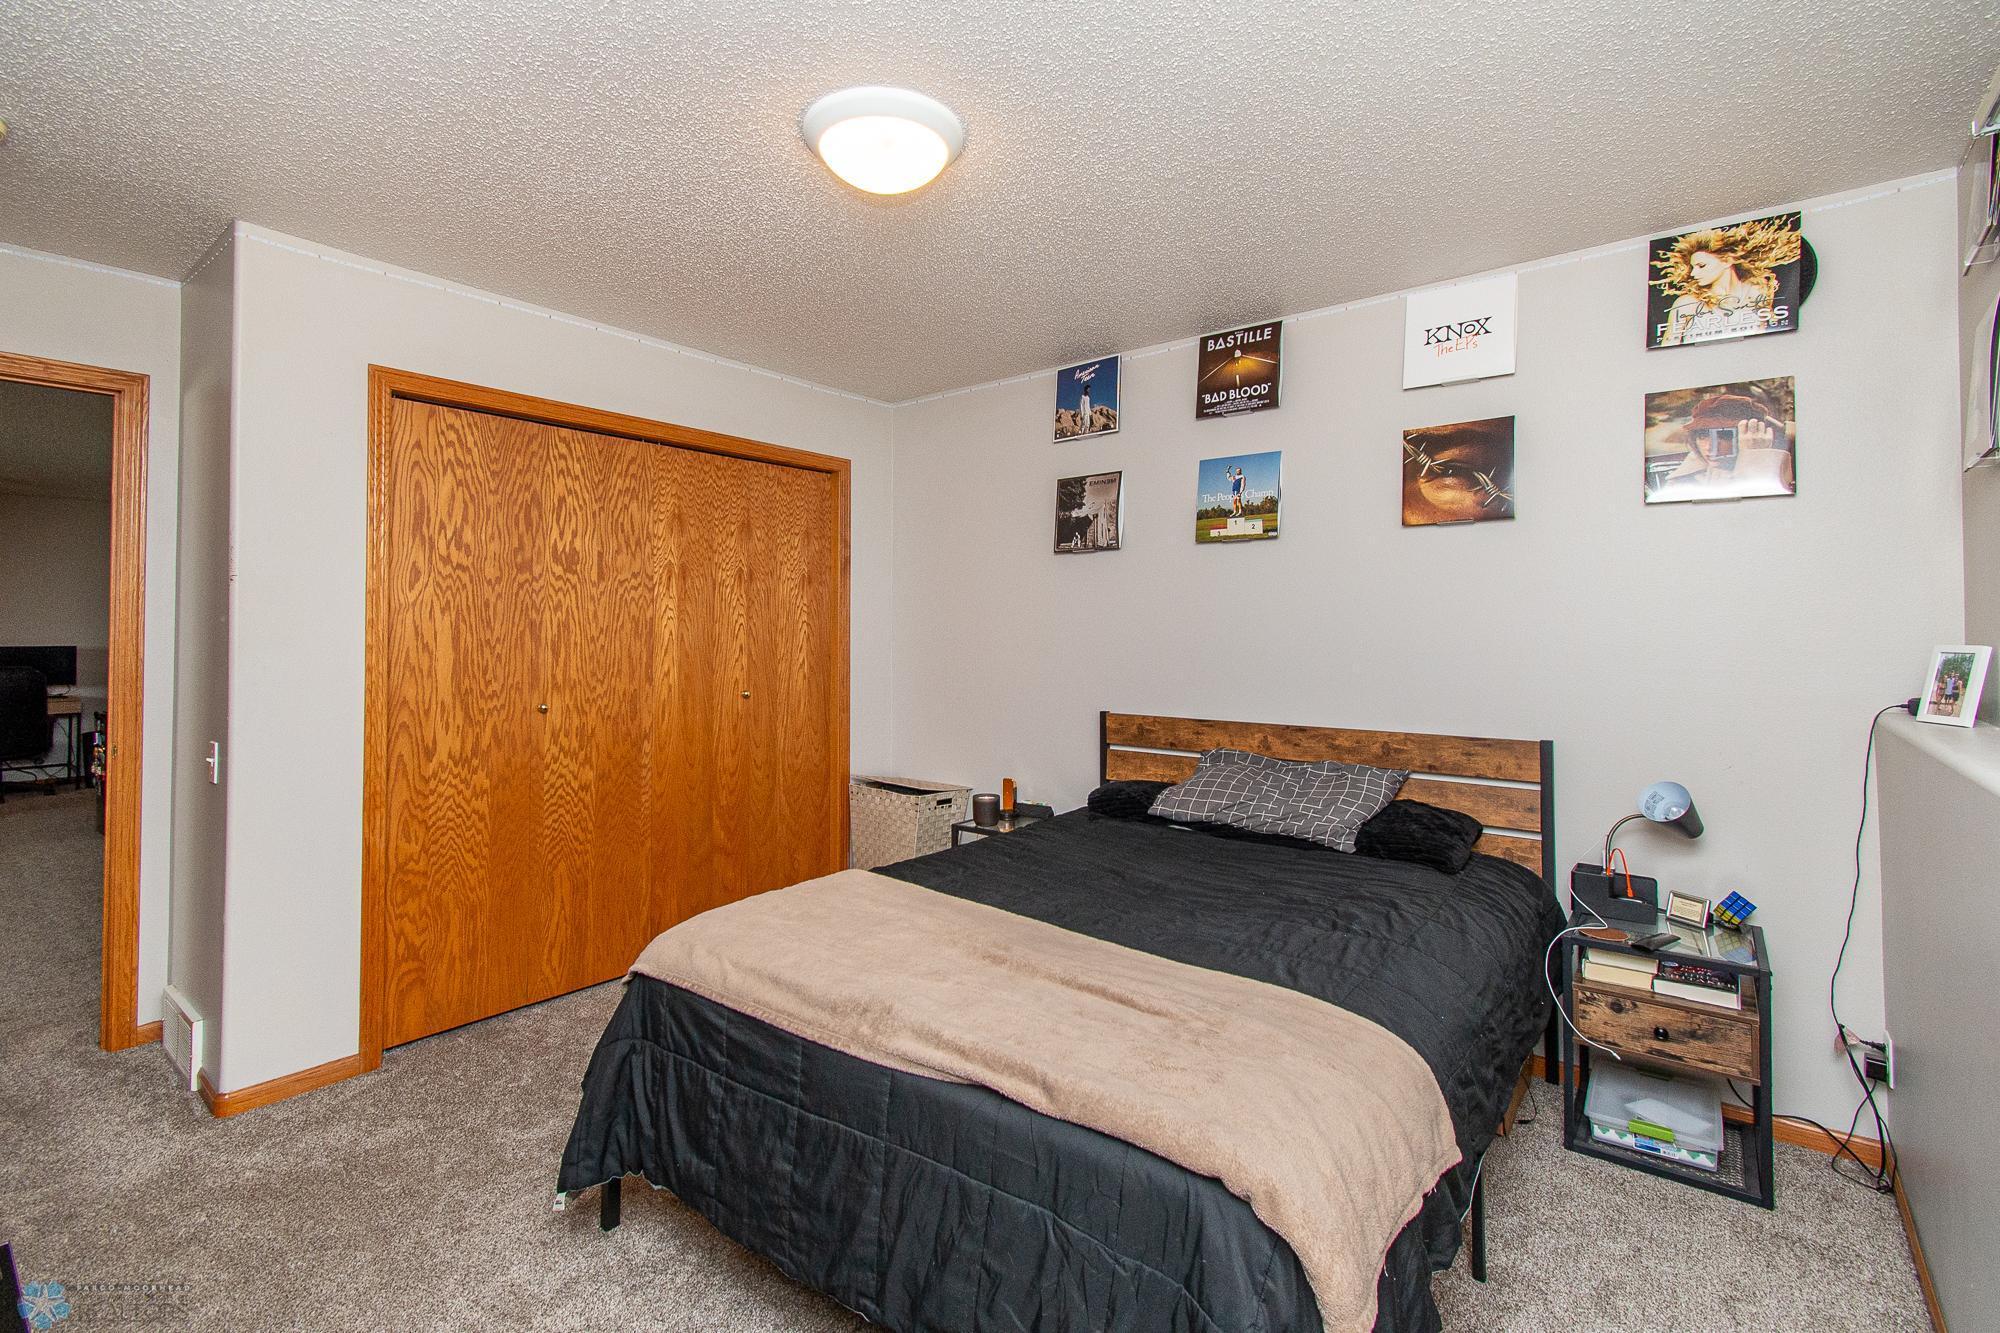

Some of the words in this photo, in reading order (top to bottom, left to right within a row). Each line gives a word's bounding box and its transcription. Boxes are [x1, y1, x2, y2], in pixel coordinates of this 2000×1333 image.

[1656, 305, 1789, 337] FEARLESS
[1207, 327, 1273, 352] BASTILLE
[1434, 343, 1454, 358] The
[1202, 494, 1217, 503] The
